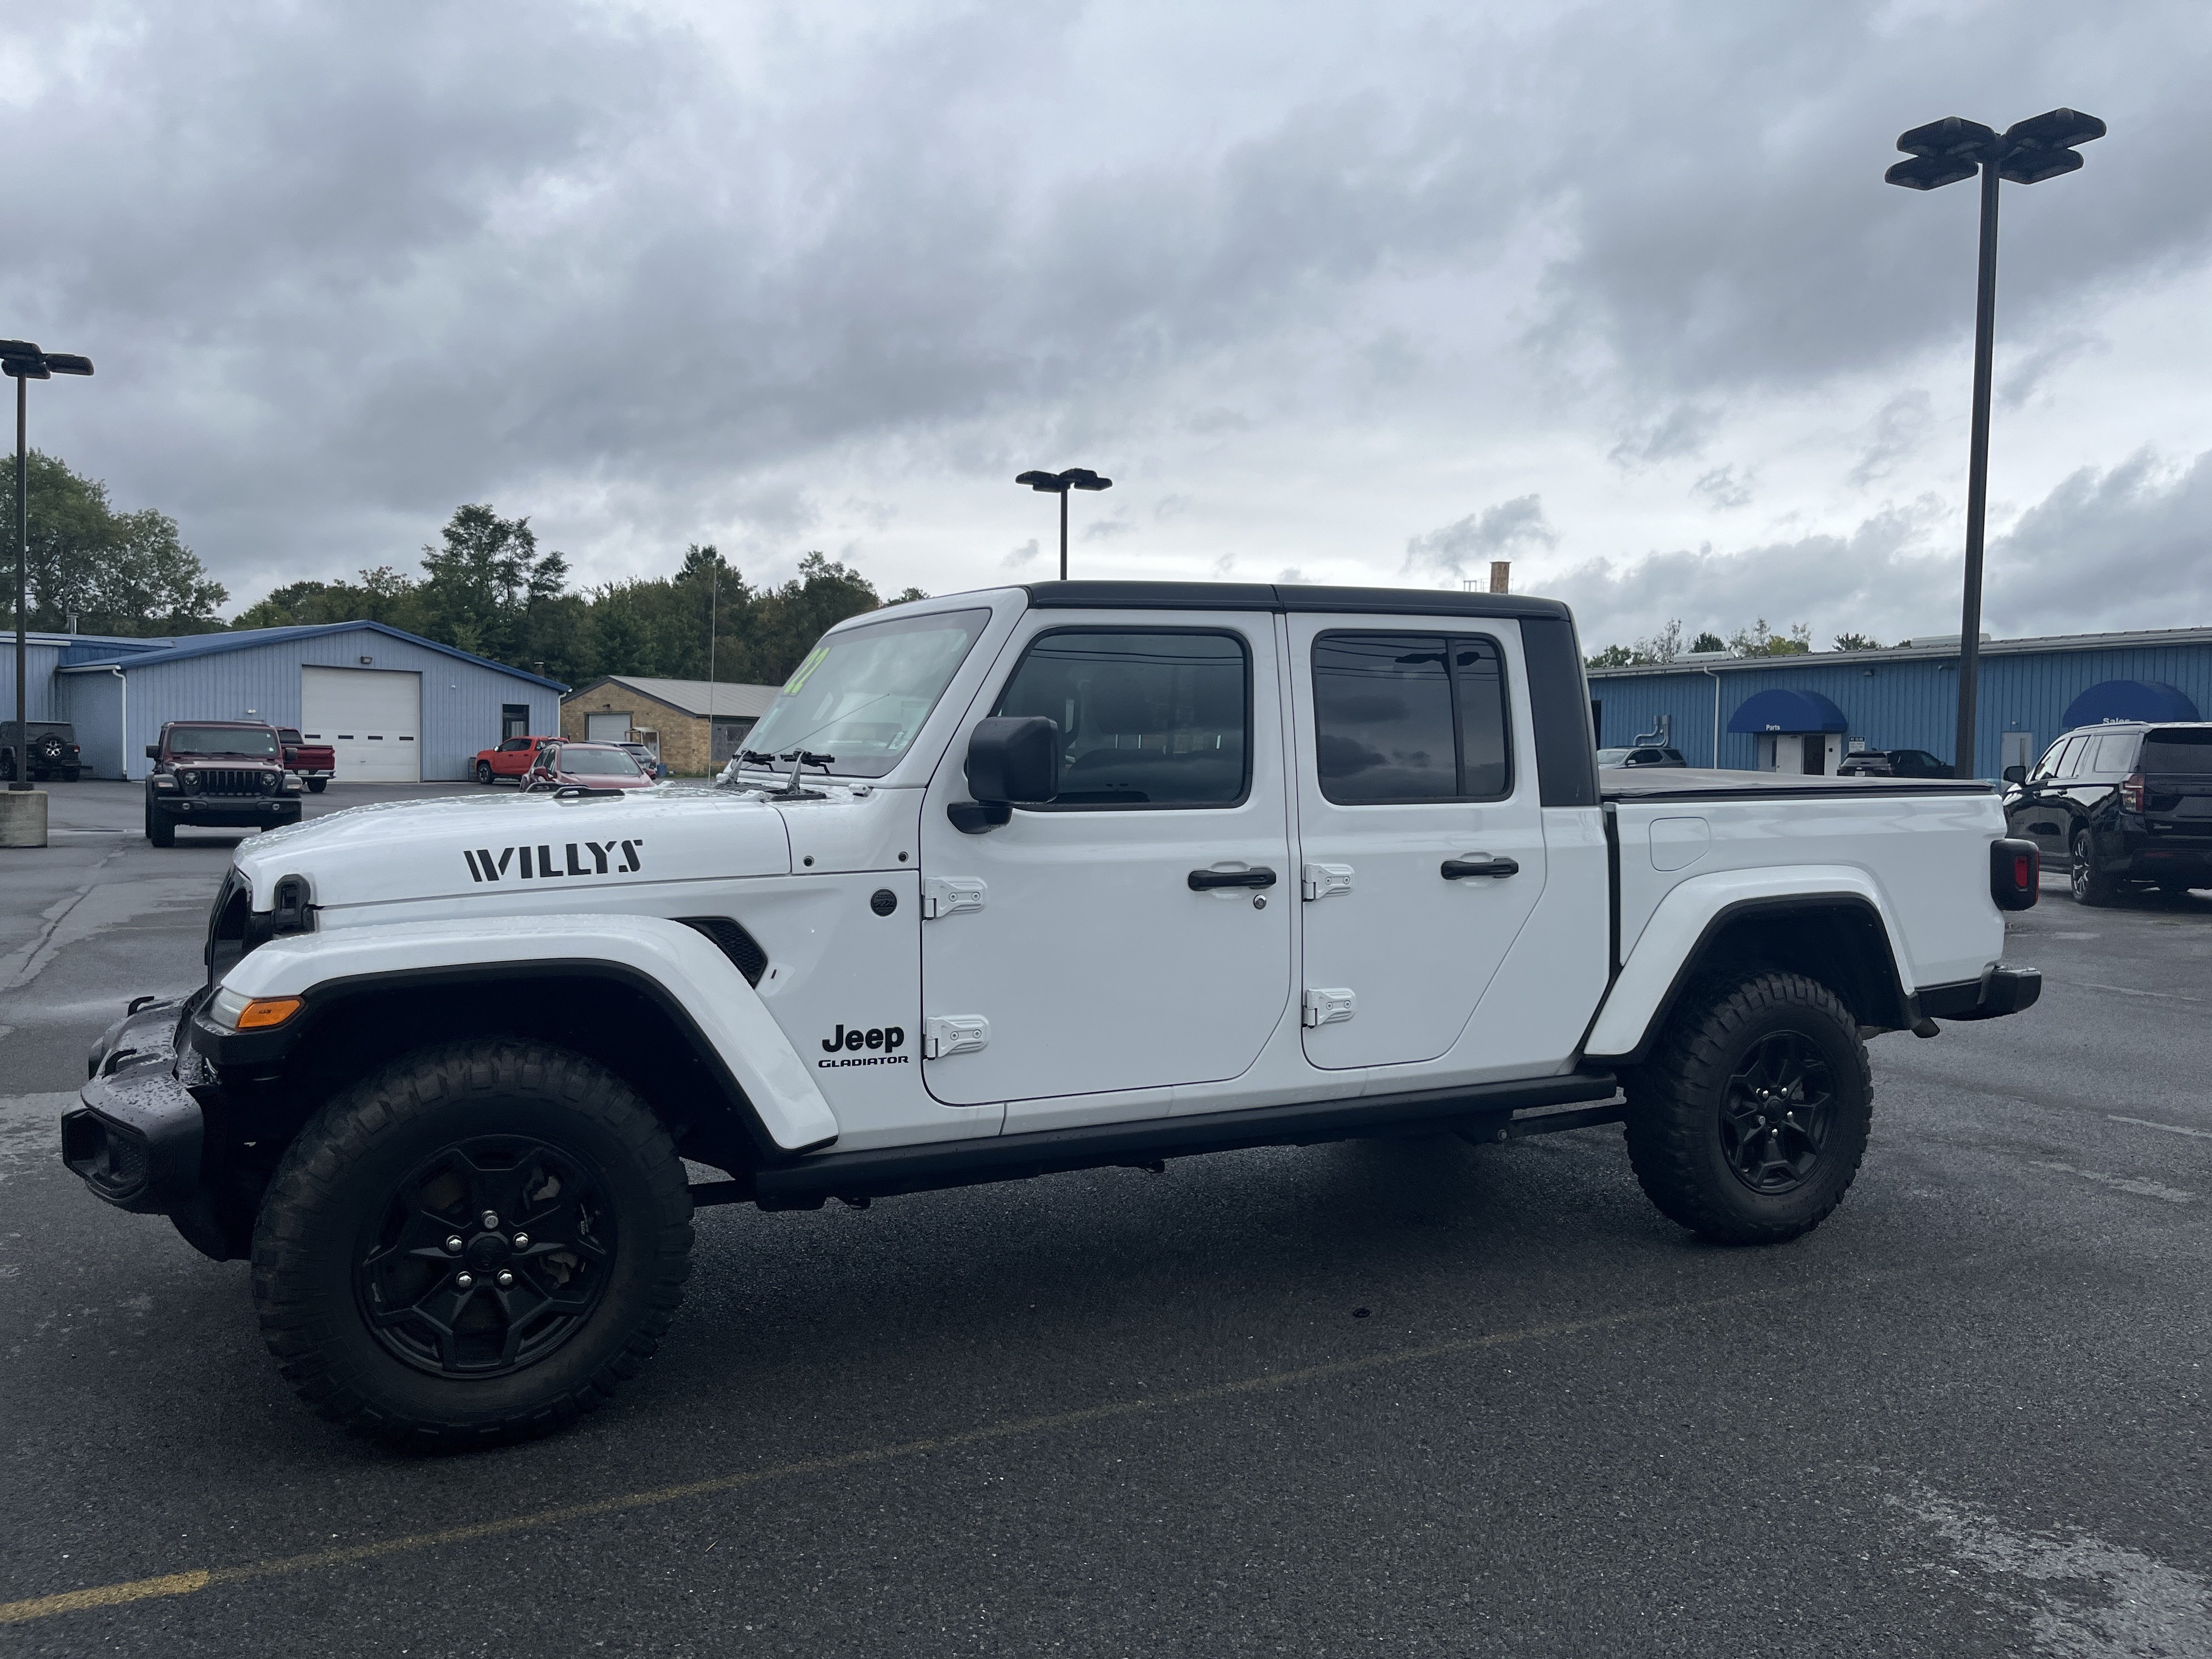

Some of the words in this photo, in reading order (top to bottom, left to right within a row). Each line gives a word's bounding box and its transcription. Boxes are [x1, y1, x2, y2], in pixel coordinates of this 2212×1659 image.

[782, 647, 830, 695] 22
[463, 839, 643, 882] WILLYS
[822, 1024, 905, 1053] Jeep
[818, 1056, 909, 1068] GLADIATOR
